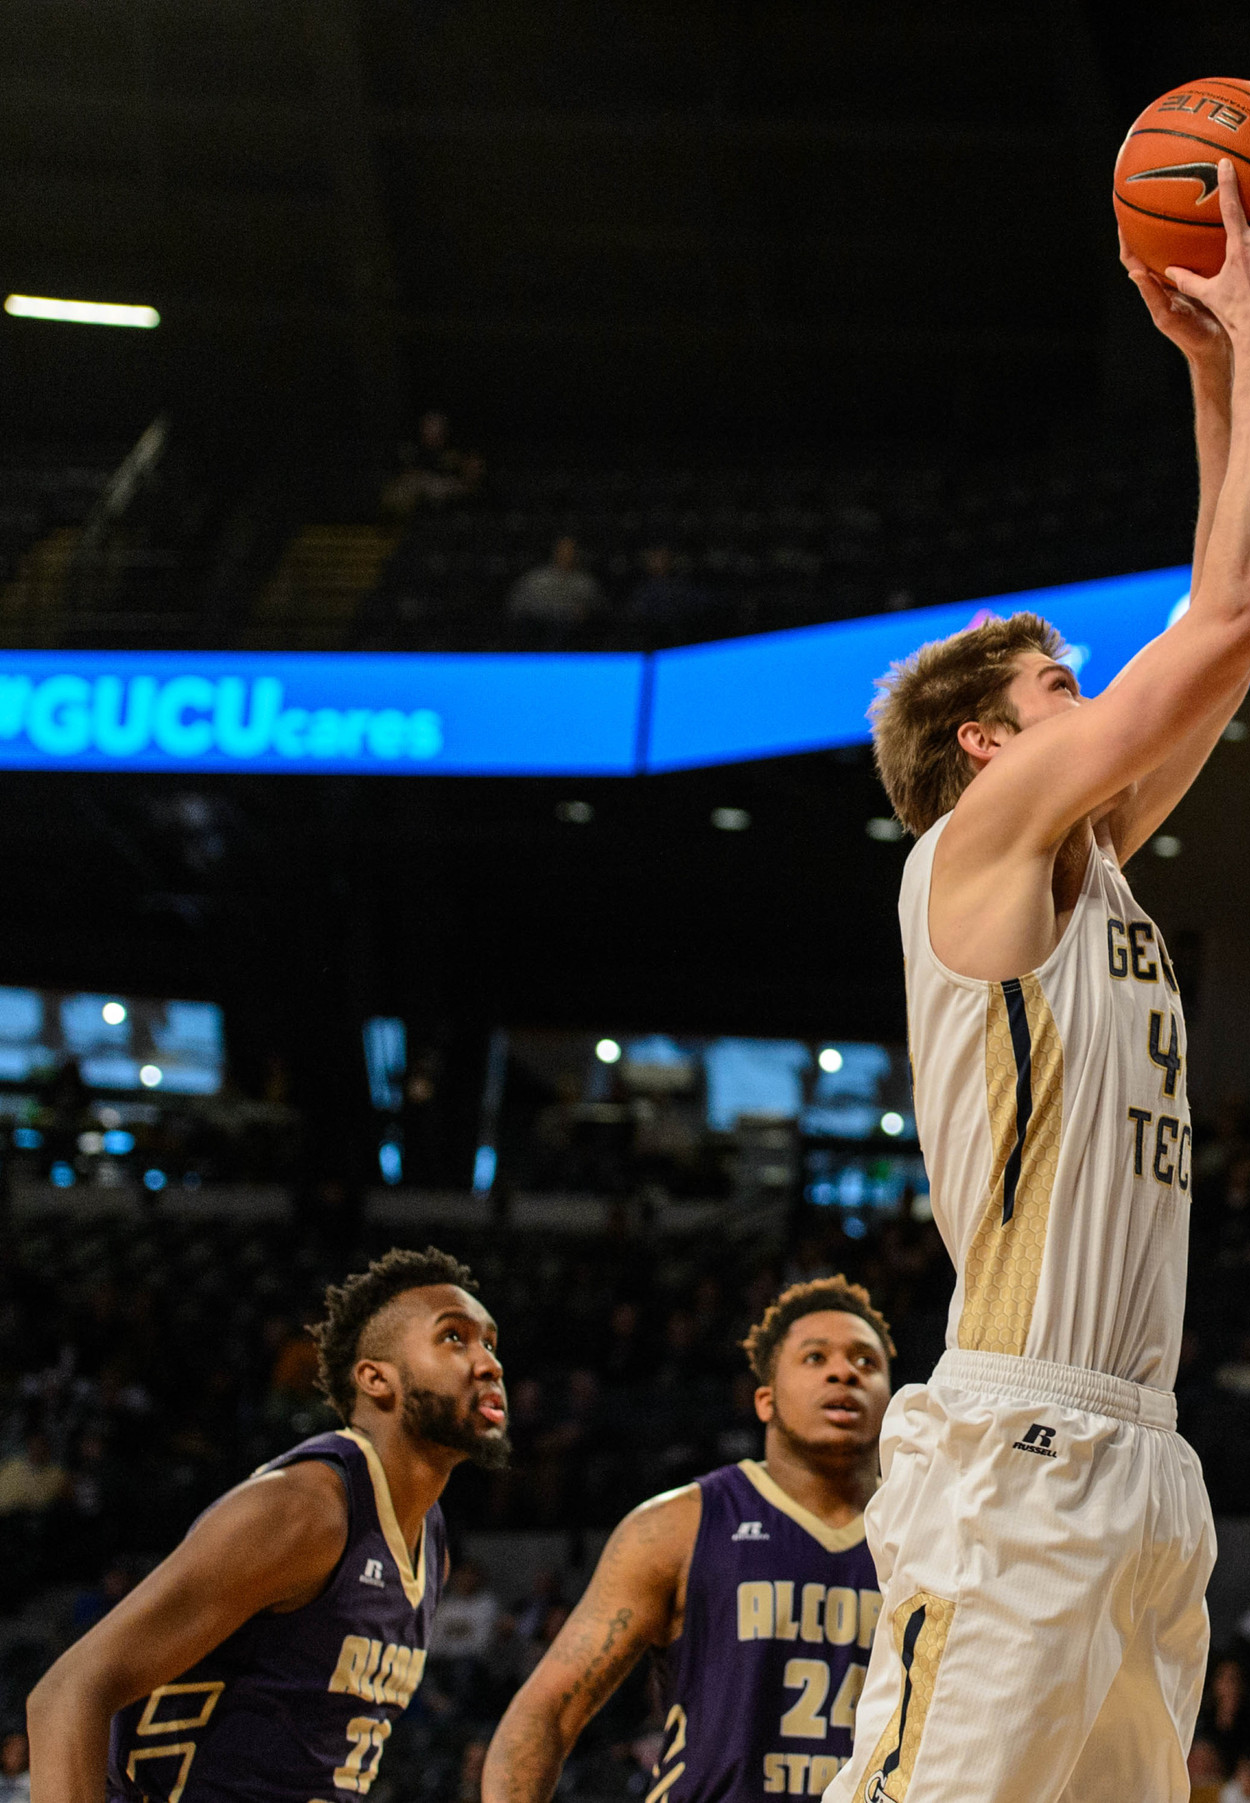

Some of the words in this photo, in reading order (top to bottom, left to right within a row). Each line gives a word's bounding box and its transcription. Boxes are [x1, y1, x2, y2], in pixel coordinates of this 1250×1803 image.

[1157, 94, 1248, 132] ELITE
[1107, 916, 1180, 994] GE
[1012, 1441, 1057, 1458] RUSSELL
[780, 1658, 867, 1739] 24
[763, 1753, 850, 1796] STA
